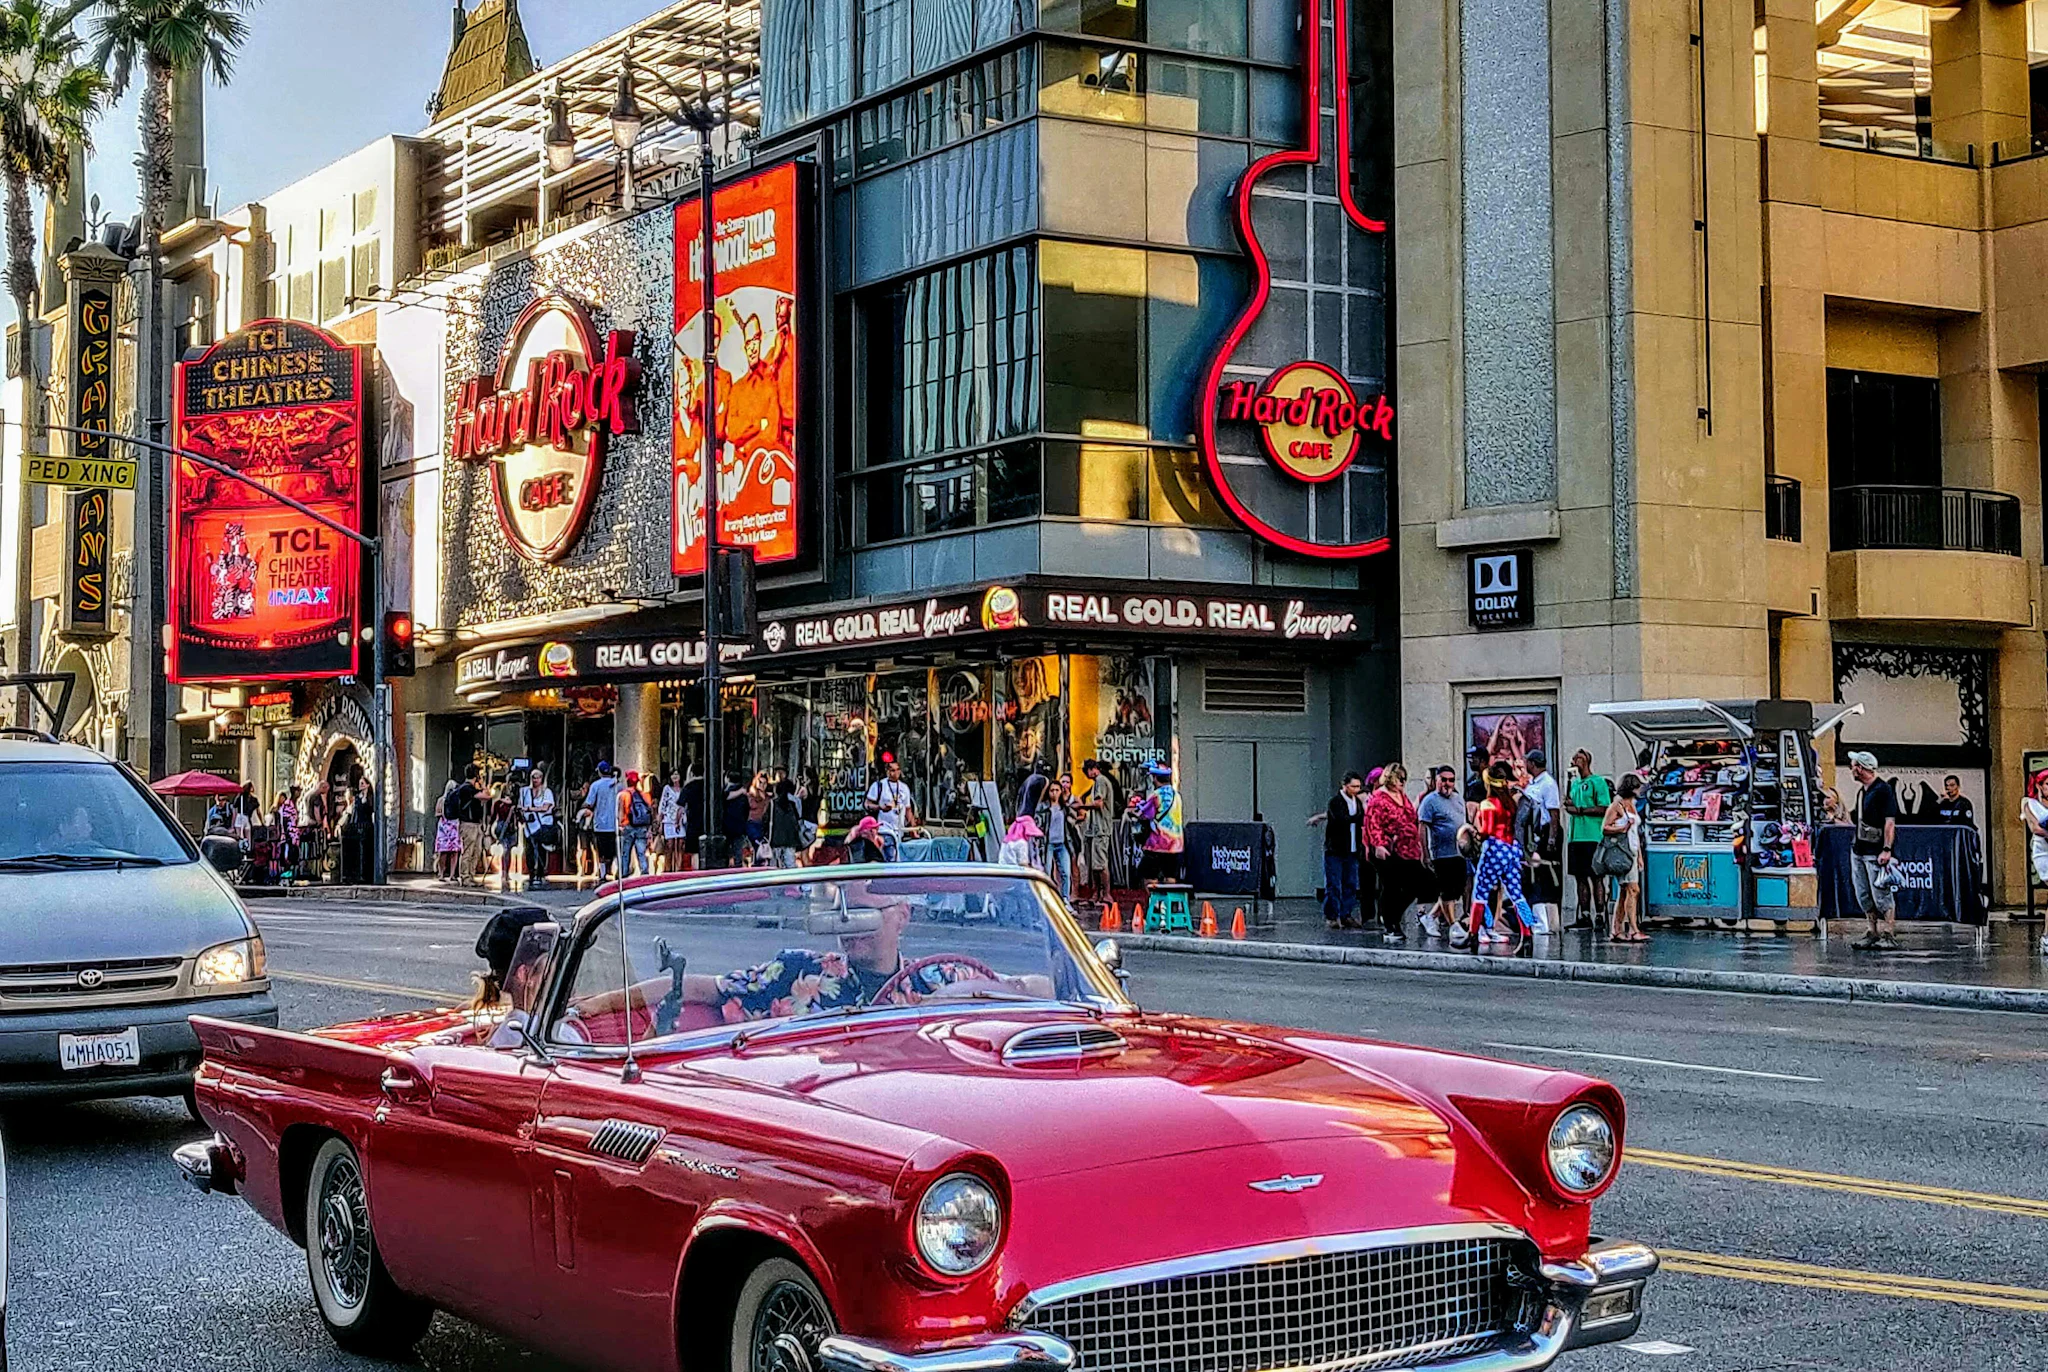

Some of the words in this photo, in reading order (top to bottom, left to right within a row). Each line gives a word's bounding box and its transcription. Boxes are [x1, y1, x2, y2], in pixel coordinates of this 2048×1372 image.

[246, 327, 293, 352] TCL
[213, 349, 324, 383] CHINESE
[202, 376, 335, 410] THEATRES
[452, 357, 541, 460] Hard
[538, 330, 628, 451] Rock
[1227, 379, 1315, 427] Hard
[1312, 388, 1395, 441] Rock
[79, 300, 110, 611] GRAUANS
[1288, 440, 1333, 460] CAFE
[29, 460, 70, 480] PED
[79, 463, 128, 484] XING
[520, 473, 572, 511] CAFE
[269, 528, 330, 553] TCL
[269, 555, 330, 573] CHINESE
[269, 571, 330, 588] THEATRE
[269, 586, 331, 606] IMAX
[1475, 595, 1517, 610] DOLBY
[795, 617, 832, 646] REAL
[833, 613, 878, 642] GOLD.
[879, 608, 920, 635] REAL
[923, 599, 971, 638] Burger.
[1048, 594, 1118, 623] REAL
[1123, 597, 1203, 627] GOLD.
[1207, 602, 1275, 630] REAL
[1283, 600, 1357, 639] Burger.
[1476, 611, 1519, 620] THEATRE
[596, 644, 649, 668] REAL
[339, 675, 356, 685] TCL
[1094, 733, 1134, 747] COME
[1094, 748, 1166, 762] TOGETHER
[828, 791, 866, 811] TOGE
[67, 1042, 134, 1065] 4MHA051
